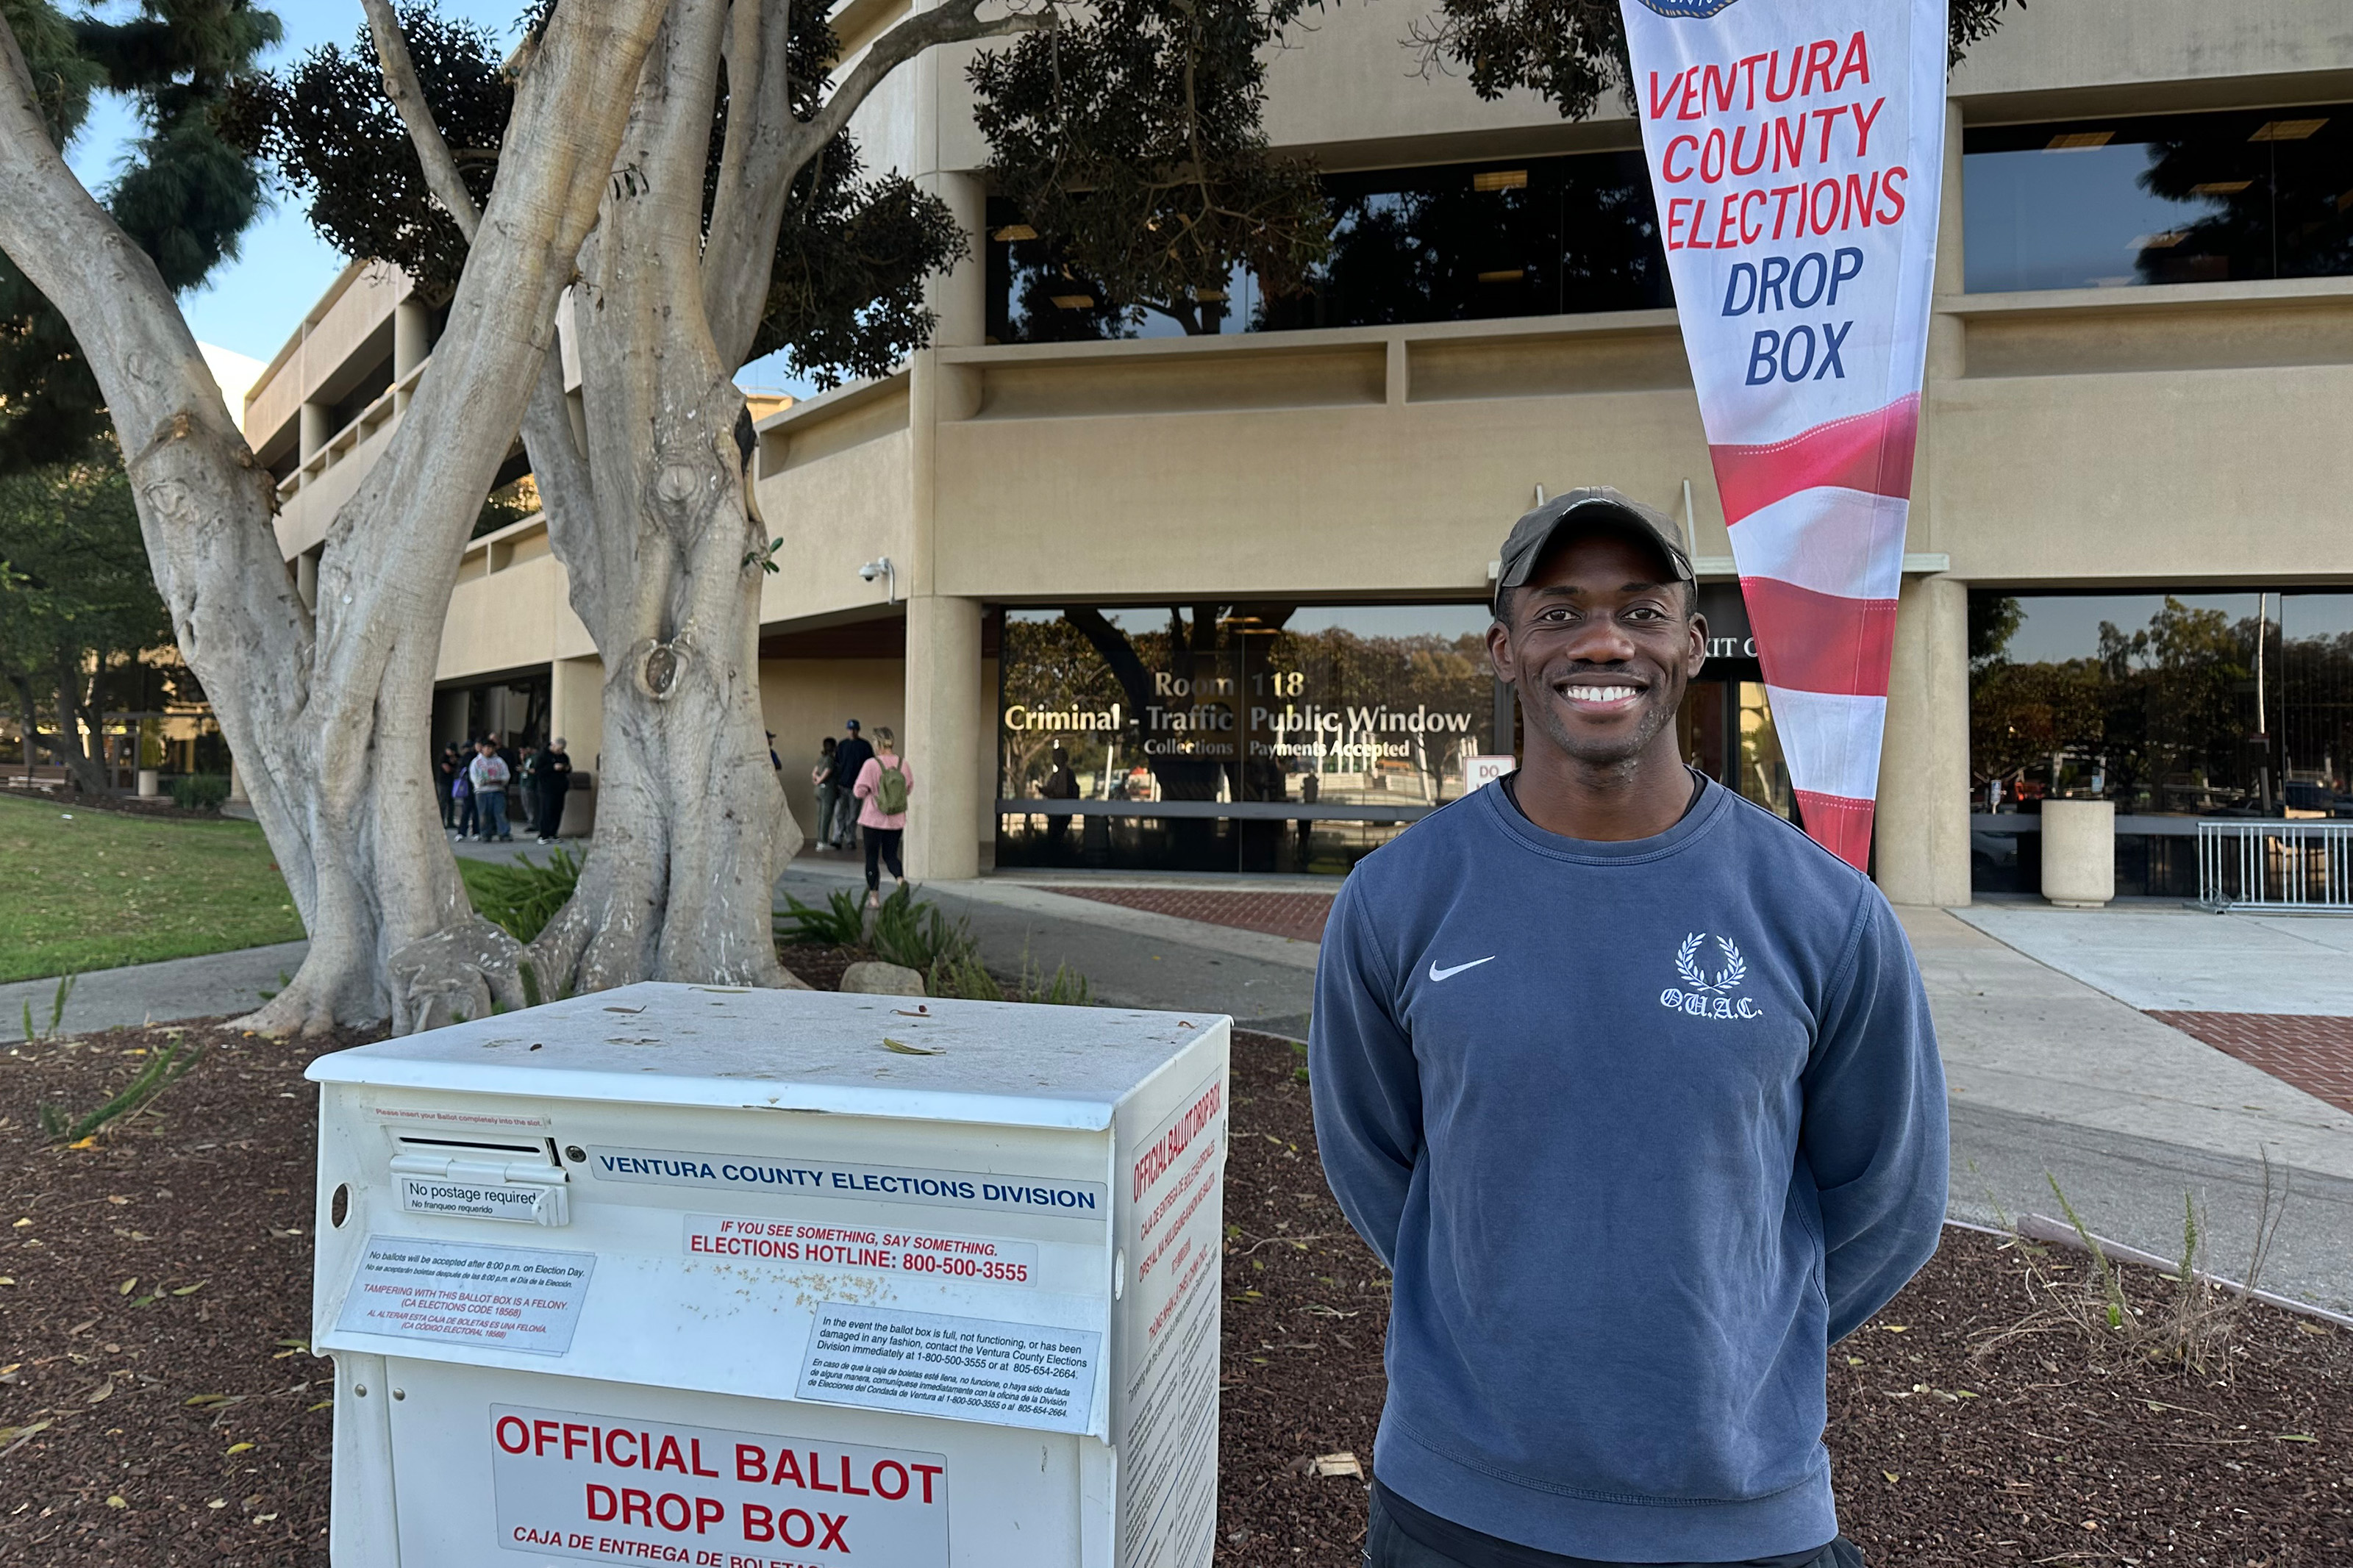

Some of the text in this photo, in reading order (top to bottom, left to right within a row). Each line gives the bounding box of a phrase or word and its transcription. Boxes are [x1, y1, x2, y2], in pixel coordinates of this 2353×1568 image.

[1650, 30, 1870, 121] VENTURA
[1662, 97, 1885, 184] COUNTY
[1668, 166, 1909, 251] ELECTIONS
[1722, 247, 1863, 316] DROP
[1746, 321, 1853, 385] BOX
[1156, 672, 1304, 698] Room 118
[1004, 704, 1120, 731] Criminal
[1146, 704, 1234, 731] Traffic
[1251, 705, 1340, 732] Public
[1344, 705, 1471, 732] Window
[1144, 739, 1410, 759] Collections Payments Accepted
[1479, 765, 1499, 778] DO
[459, 1116, 497, 1124] completely
[1133, 1079, 1221, 1203] OFFICIAL BALLOT DROP BOX
[410, 1182, 535, 1205] No postage required
[600, 1156, 1095, 1209] VENTURA COUNTY ELECTIONS DIVISION
[412, 1200, 493, 1214] No franqueo requerido
[721, 1220, 997, 1256] IF YOU SEE SOMETHING, SAY SOMETHING.
[369, 1251, 380, 1259] No
[382, 1253, 406, 1261] ballots
[421, 1256, 430, 1264] be
[432, 1257, 466, 1267] accepted
[468, 1260, 485, 1268] after
[487, 1261, 504, 1270] 8:00
[535, 1264, 565, 1275] Election
[568, 1267, 584, 1278] Day.
[691, 1235, 1026, 1281] ELECTIONS HOTLINE: 800-500-3555
[365, 1284, 413, 1295] TAMPERING
[415, 1288, 436, 1297] WITH
[438, 1291, 457, 1300] THIS
[459, 1292, 492, 1303] BALLOT
[493, 1295, 512, 1305] BOX
[513, 1297, 522, 1306] IS
[524, 1298, 529, 1306] A
[401, 1298, 521, 1318] (CA ELECTIONS CODE 18568)
[376, 1310, 408, 1320] ALTERAR
[409, 1313, 426, 1321] ESTA
[428, 1314, 445, 1322] CAJA
[456, 1317, 489, 1328] BOLETAS
[500, 1322, 515, 1330] UNA
[415, 1322, 443, 1332] CÓDIGO
[443, 1326, 482, 1336] ELECTORAL
[485, 1331, 507, 1339] 18568)
[822, 1316, 1081, 1354] In the event the ballot box is full, not functioning, or has been
[816, 1339, 850, 1352] Division
[851, 1344, 904, 1360] immediately
[906, 1351, 914, 1359] at
[918, 1351, 986, 1368] 1-800-500-3555
[819, 1329, 1087, 1367] damaged in any fashion, contact the Ventura County Elections
[818, 1379, 854, 1390] Elecciones
[866, 1385, 898, 1396] Condada
[910, 1391, 936, 1400] Ventura
[946, 1395, 1000, 1408] 1-800-500-3555
[819, 1370, 1067, 1406] alguna manera, comuníquese inmediatamente oficina División
[872, 1366, 887, 1375] caja
[897, 1369, 923, 1378] boletas
[940, 1373, 957, 1383] llena,
[971, 1378, 1000, 1389] funcione,
[1009, 1382, 1026, 1392] haya
[1044, 1386, 1070, 1396] dañada
[496, 1416, 943, 1504] OFFICIAL BALLOT
[586, 1483, 851, 1553] DROP BOX
[513, 1527, 562, 1546] CAJA
[568, 1534, 594, 1550] DE
[599, 1538, 691, 1564] ENTREGA
[696, 1550, 724, 1567] DE
